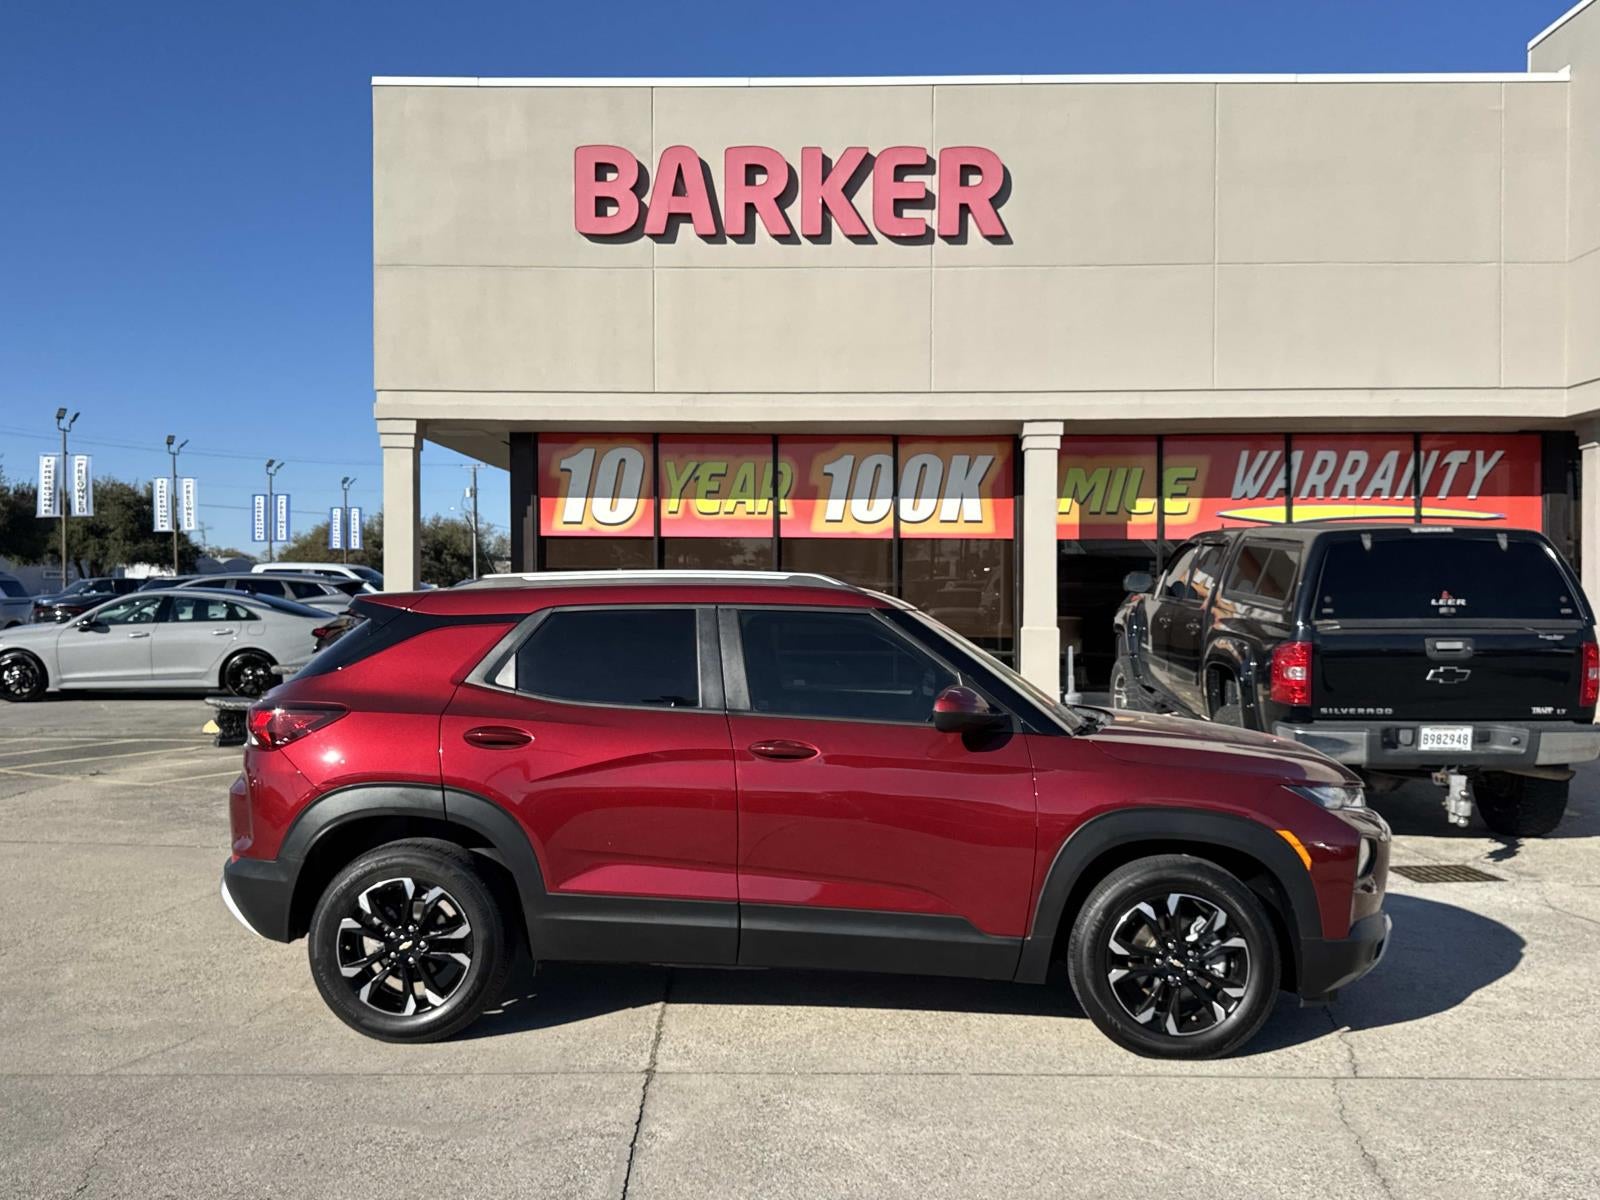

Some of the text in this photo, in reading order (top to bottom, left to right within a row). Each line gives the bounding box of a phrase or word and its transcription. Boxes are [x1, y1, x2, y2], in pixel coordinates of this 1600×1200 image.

[574, 144, 1008, 240] BARKER
[560, 447, 1505, 526] 10 YEAR 100K MILE WARRANTY
[1430, 598, 1466, 606] LEER
[1320, 707, 1393, 715] SILVERADO
[1423, 733, 1469, 746] B982948
